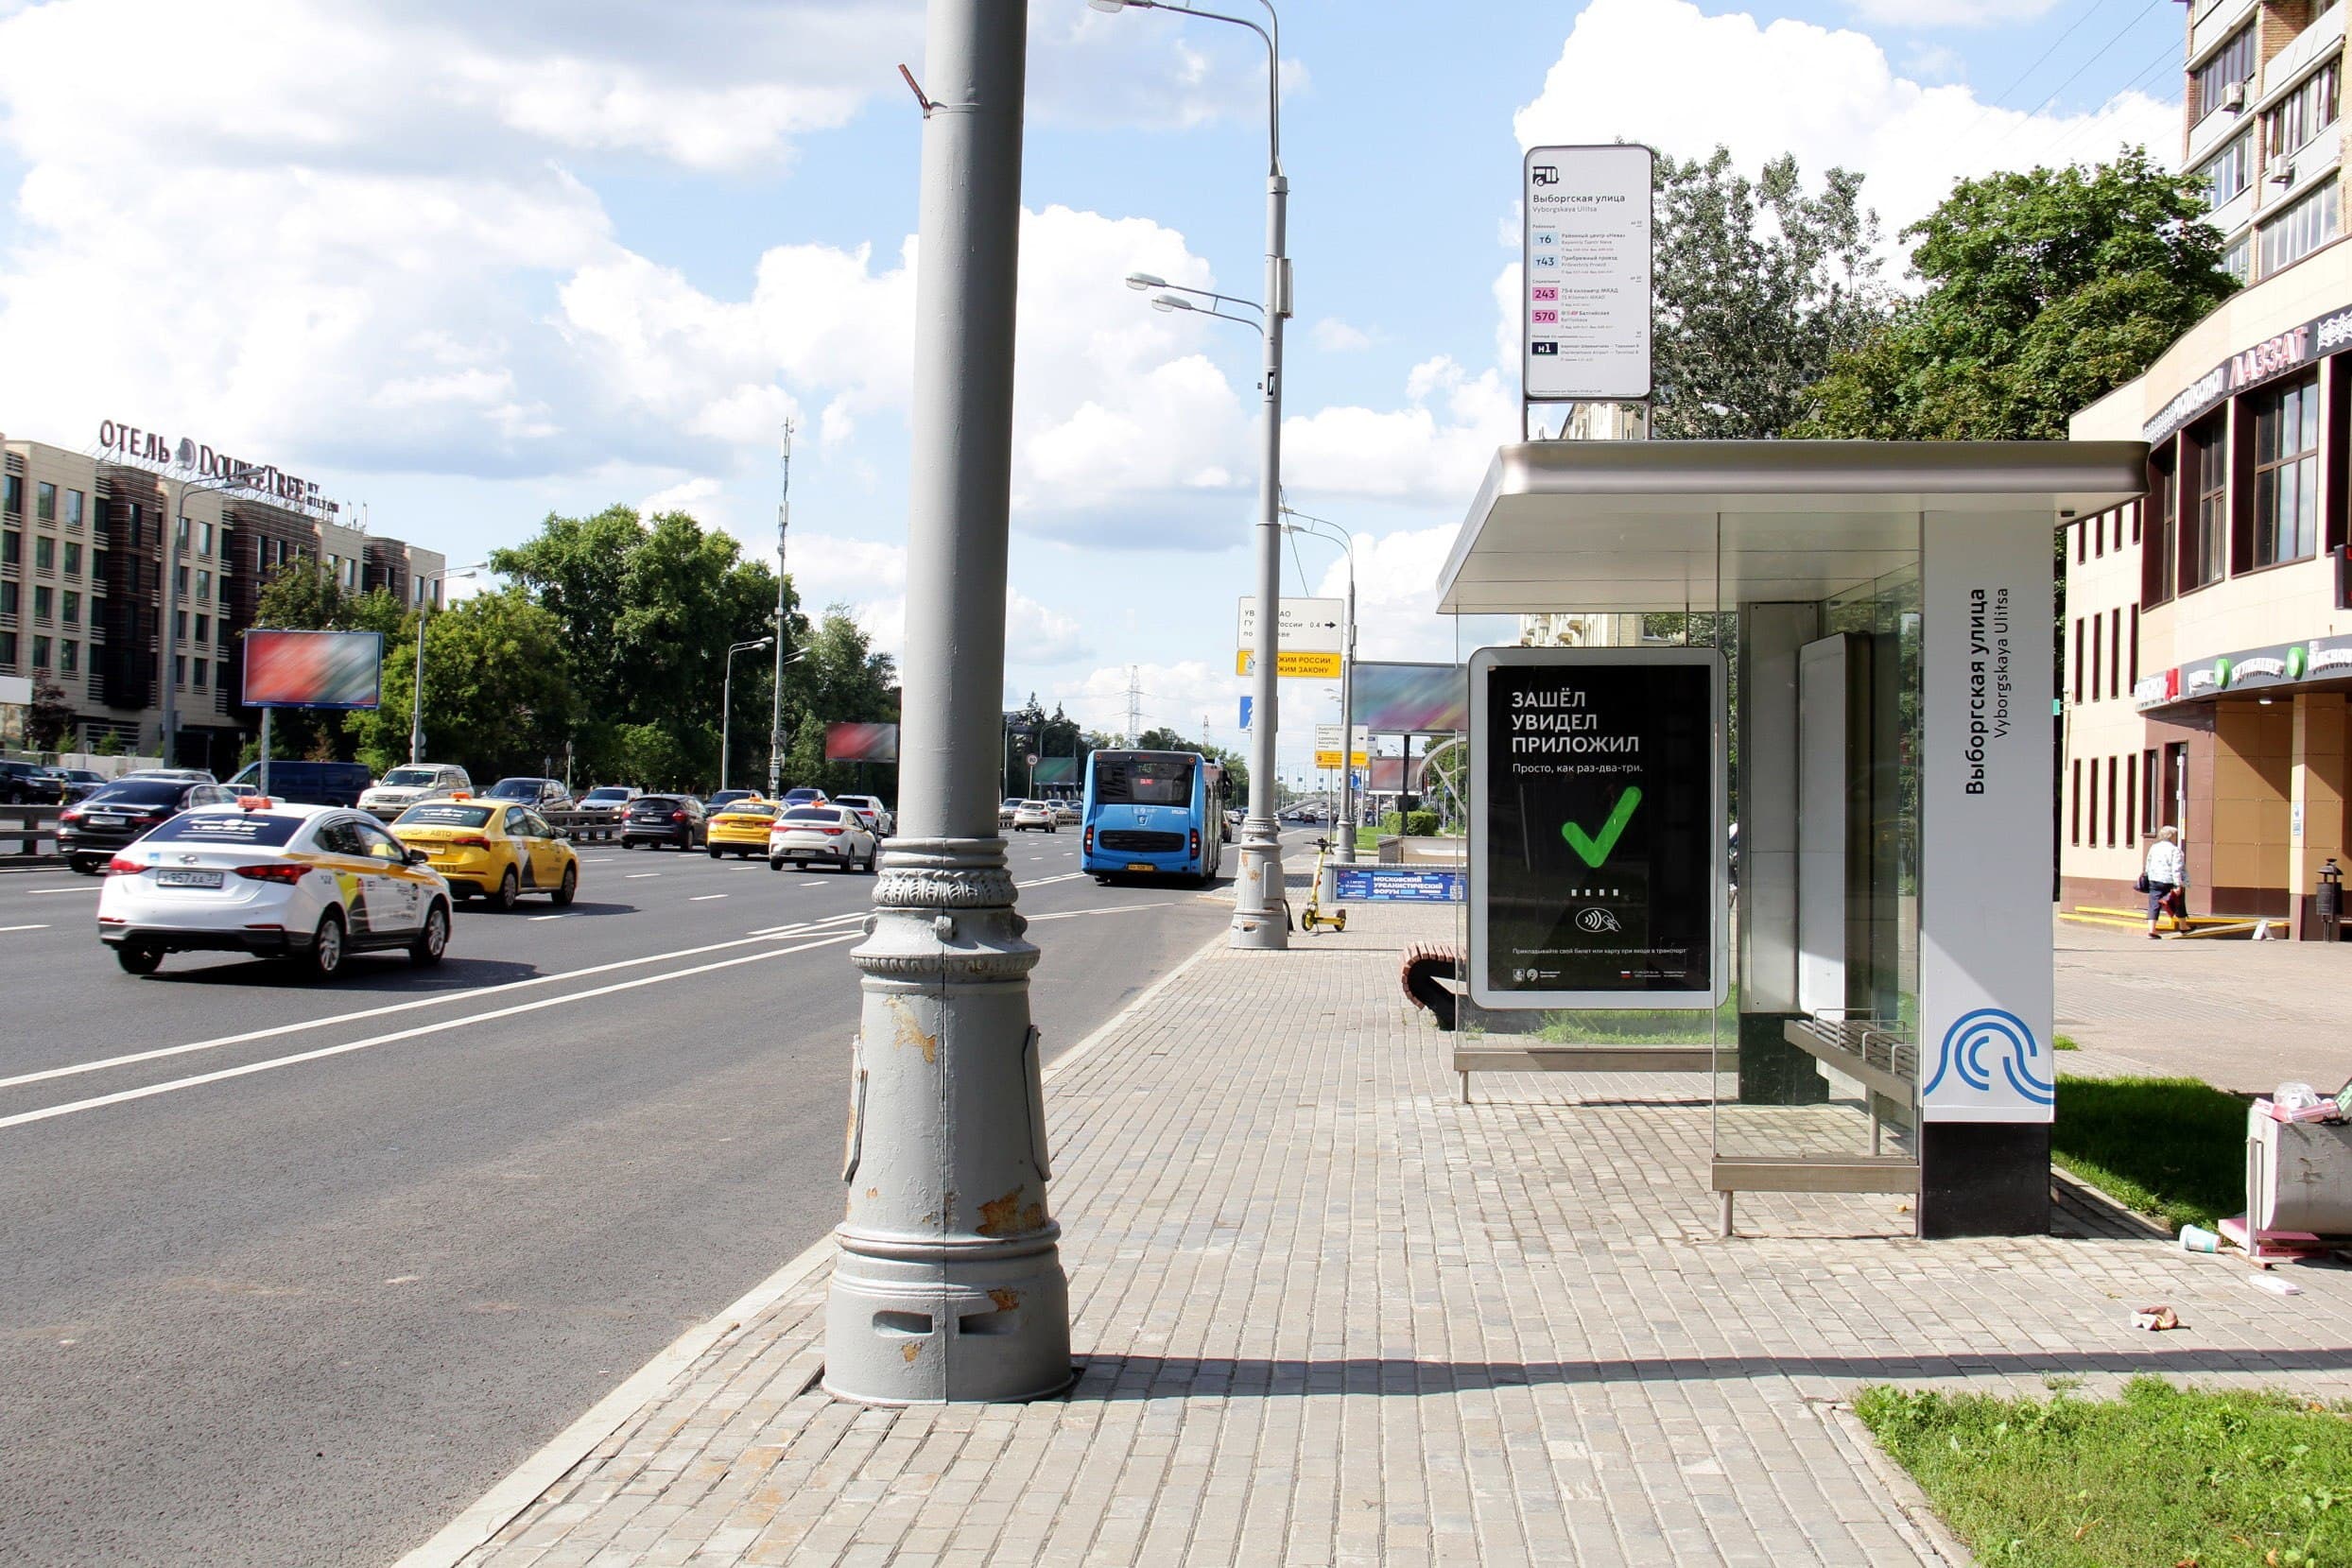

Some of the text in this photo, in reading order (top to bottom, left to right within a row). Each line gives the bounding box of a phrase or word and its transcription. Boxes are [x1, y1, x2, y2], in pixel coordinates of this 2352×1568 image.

[1532, 195, 1625, 205] Выборгская улица
[1539, 234, 1552, 244] т6
[1535, 257, 1555, 267] т43
[1534, 289, 1555, 299] 243
[1534, 312, 1555, 321] 570
[2228, 326, 2309, 389] ЛАЗЗАТ
[99, 419, 171, 464] ОТЕЛЬ
[1994, 588, 2012, 738] Vyborgskaya Ulitsa
[1512, 687, 1586, 708] ЗАШЁЛ
[1965, 589, 1990, 795] Выборгская улица
[1512, 714, 1598, 732] УВИДЕЛ
[1513, 736, 1639, 753] ПРИЛОЖИЛ
[1513, 763, 1643, 774] Просто, как раз-два-три.
